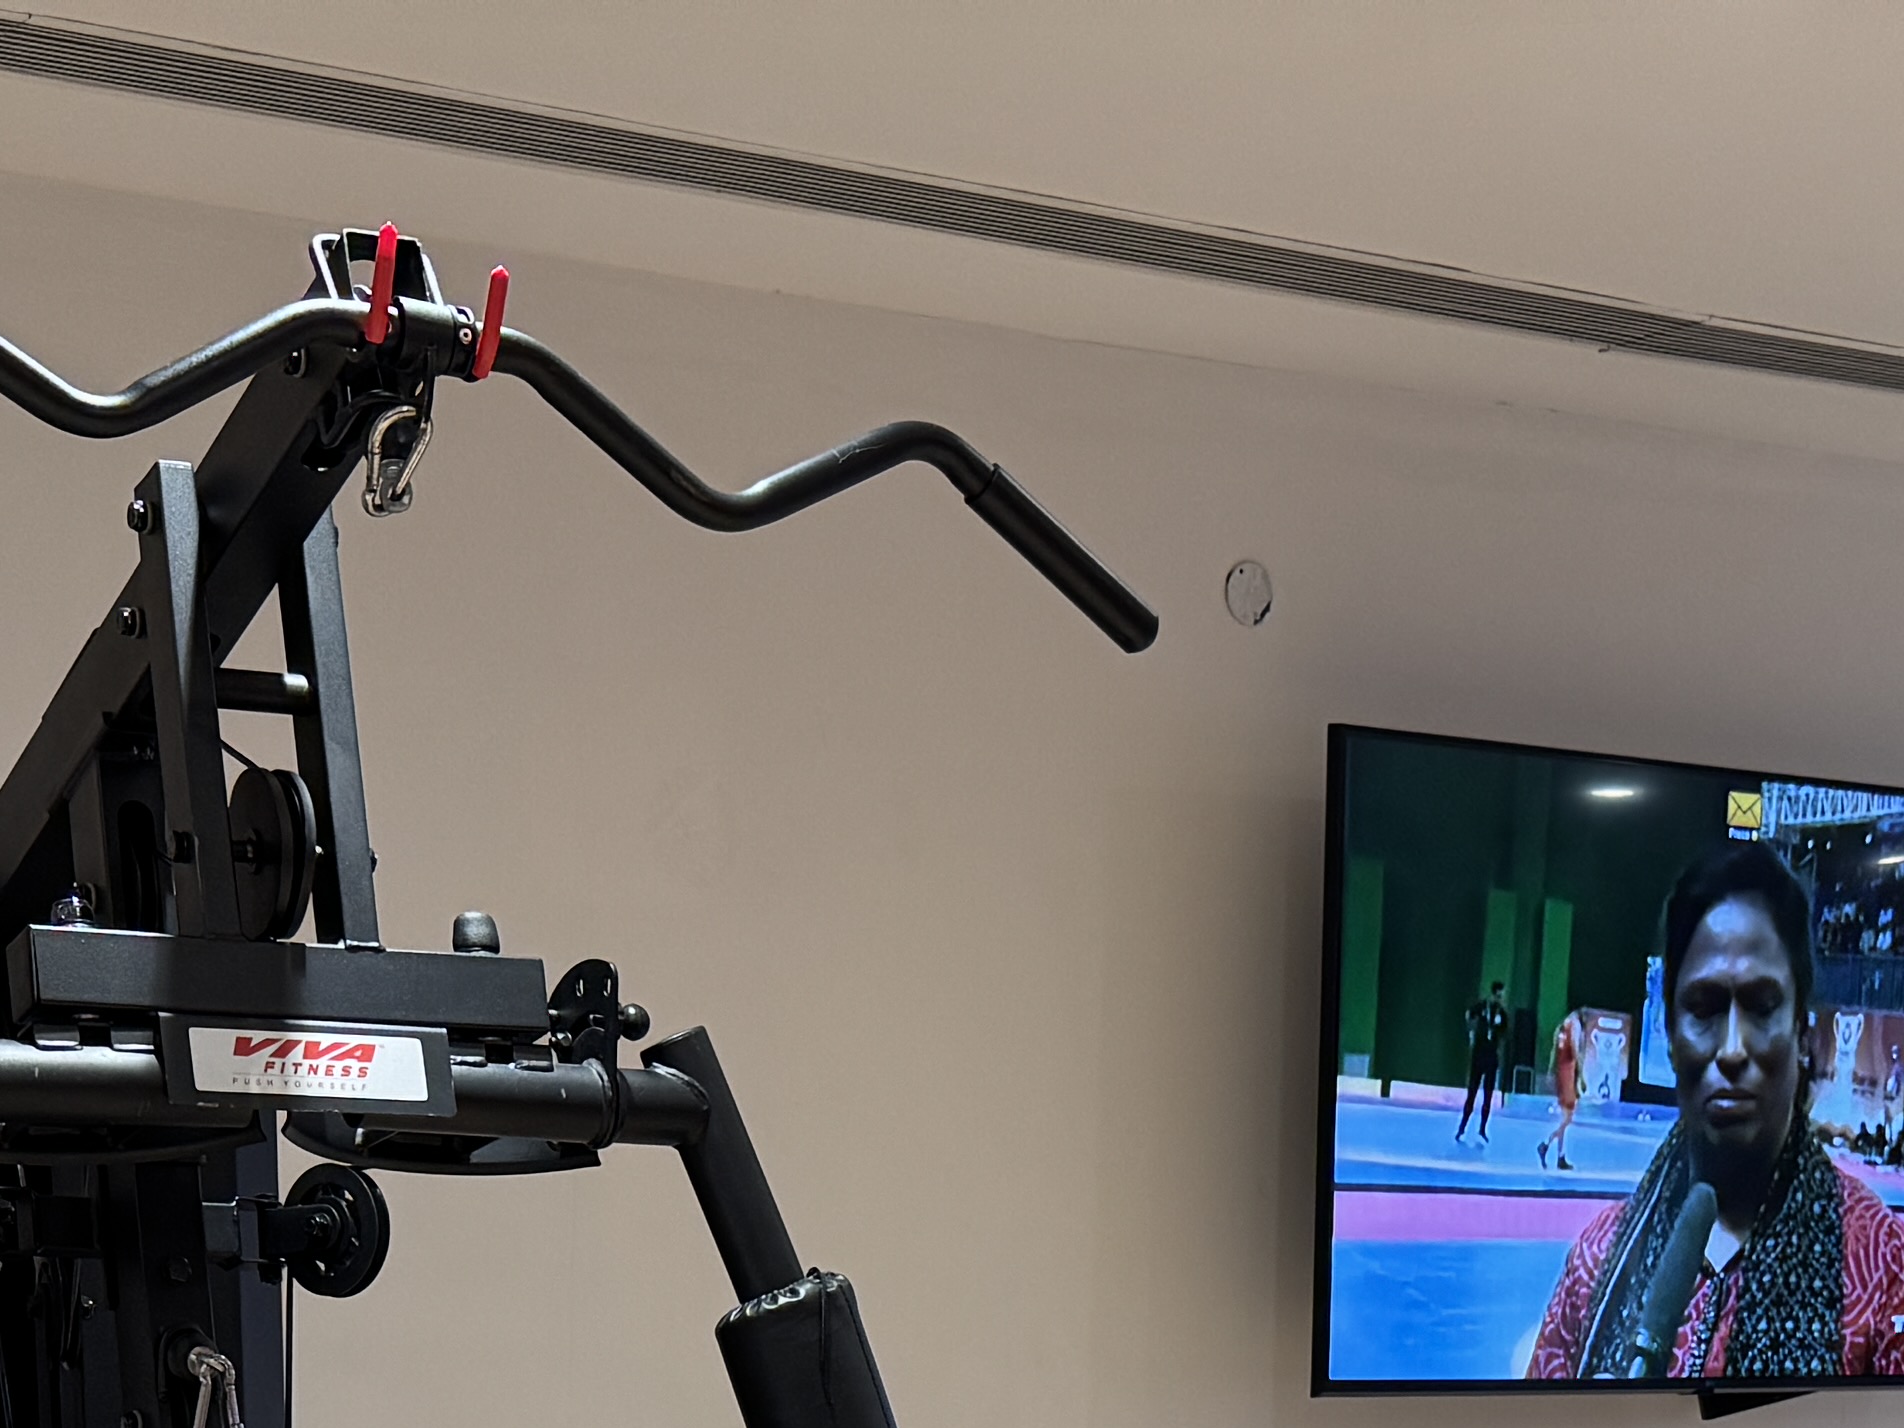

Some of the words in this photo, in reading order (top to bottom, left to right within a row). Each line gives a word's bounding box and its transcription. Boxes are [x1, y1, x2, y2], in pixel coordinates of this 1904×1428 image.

[232, 1036, 380, 1063] VIVA
[263, 1060, 370, 1078] FITNESS
[232, 1076, 275, 1088] PUSH
[282, 1079, 368, 1092] YOURSELF
